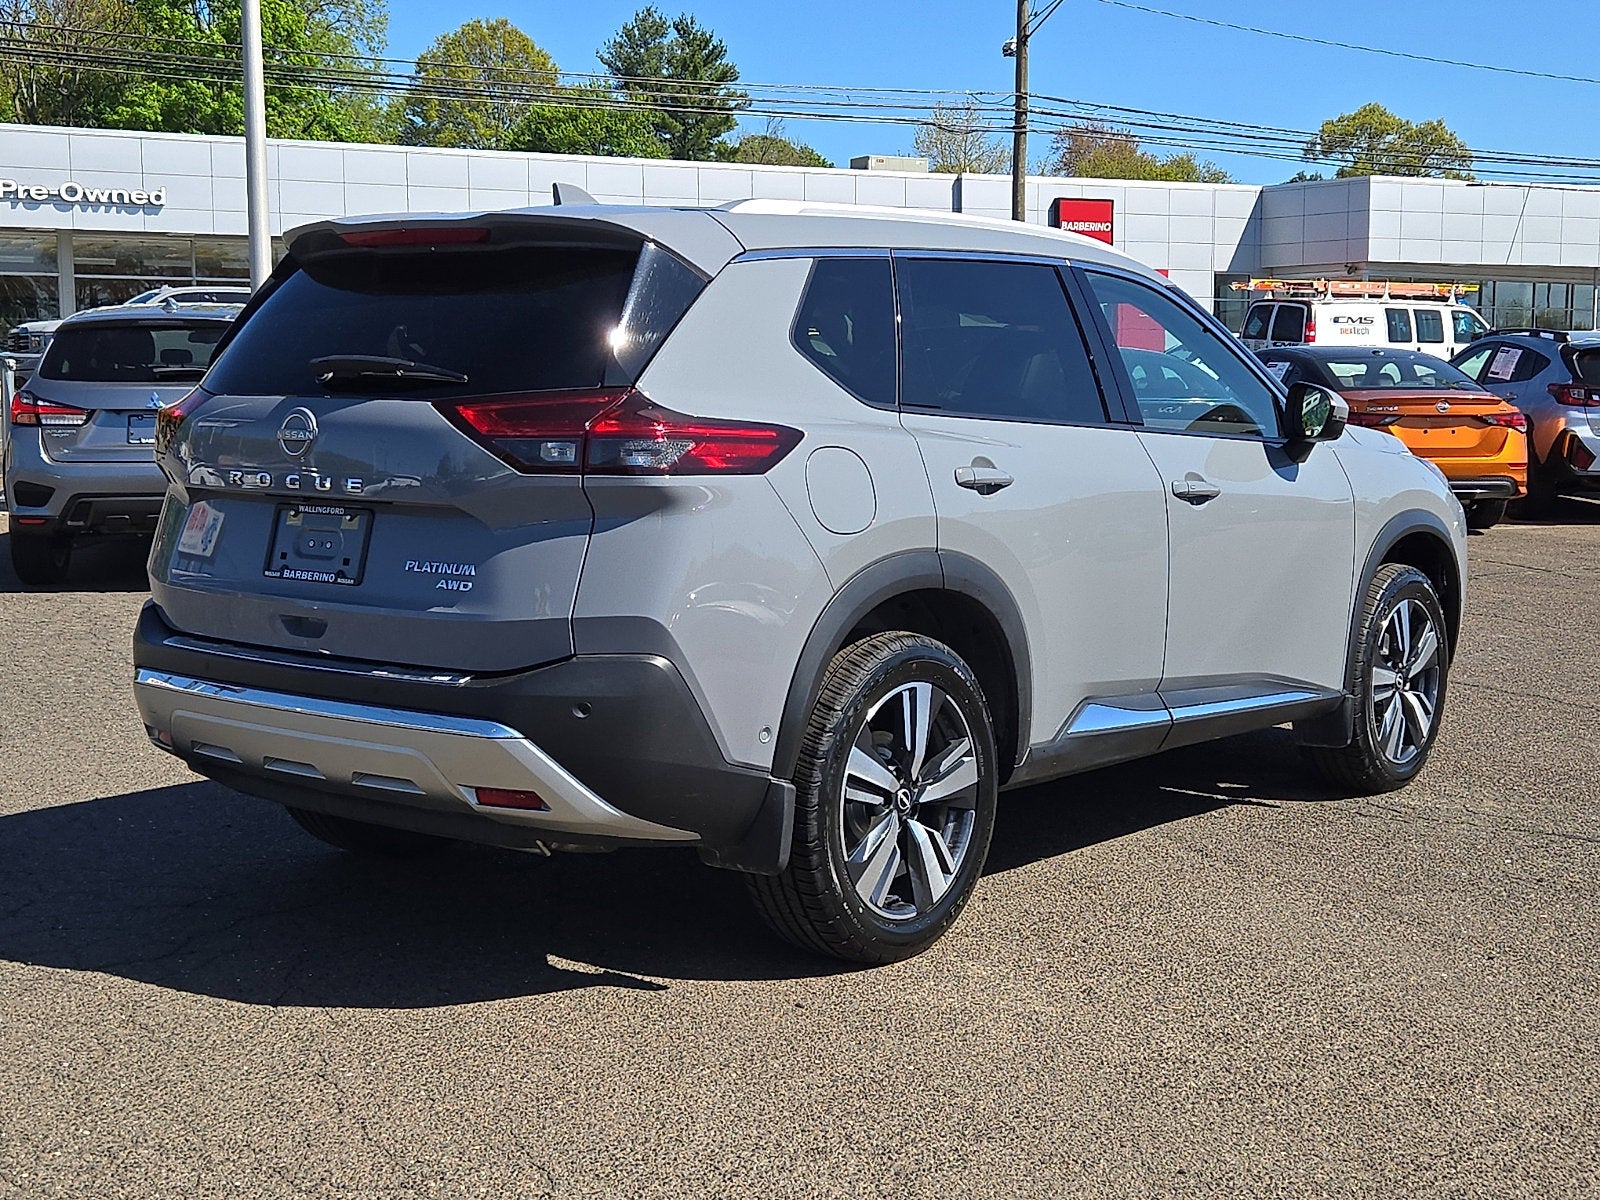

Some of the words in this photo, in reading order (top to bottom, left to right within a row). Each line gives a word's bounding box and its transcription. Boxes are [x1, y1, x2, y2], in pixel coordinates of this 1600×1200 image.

[0, 179, 166, 206] Pre-Owned
[1061, 221, 1112, 232] BARBERINO
[1333, 316, 1375, 325] CMS
[277, 430, 314, 440] NISSAN
[229, 470, 363, 493] ROGUE
[298, 504, 345, 515] WALLINGFORD
[405, 560, 476, 576] PLATINUM
[283, 569, 336, 582] BARBERINO
[435, 579, 473, 592] AWD
